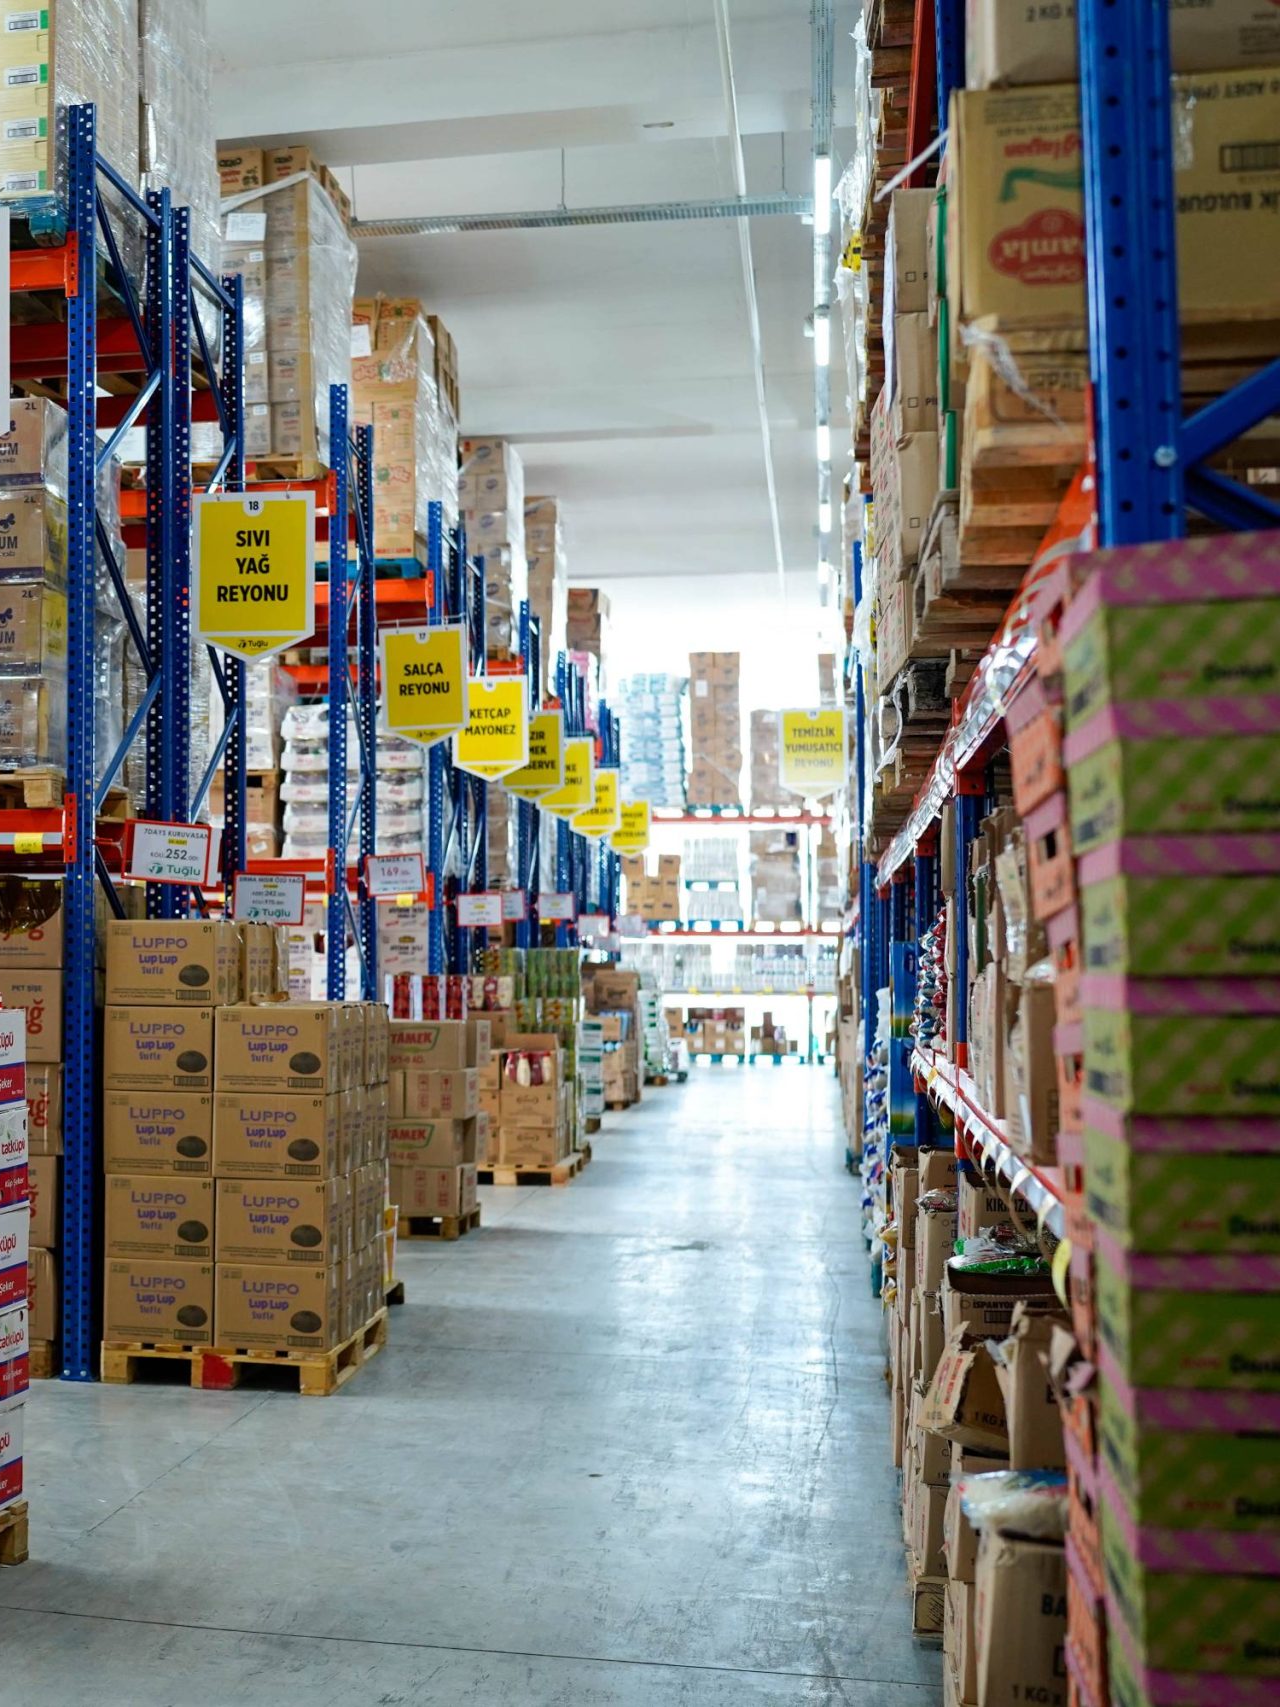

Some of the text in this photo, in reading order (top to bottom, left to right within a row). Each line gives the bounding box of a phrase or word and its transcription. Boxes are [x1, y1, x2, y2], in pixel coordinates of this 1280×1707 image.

[1001, 237, 1081, 262] amla
[25, 401, 37, 410] 2L
[249, 501, 259, 510] 18
[236, 530, 270, 547] SIVI
[236, 554, 270, 574] YAĞ
[22, 590, 33, 598] 2L
[217, 585, 289, 602] REYONU
[404, 662, 444, 678] SALÇA
[399, 681, 450, 696] REYONU
[469, 708, 511, 719] KETÇAP
[464, 724, 516, 736] MAYONEZ
[529, 731, 545, 740] ZIR
[167, 864, 200, 877] Tuğlu
[263, 908, 291, 918] Tuğlu
[132, 936, 188, 949] LUPPO
[139, 954, 178, 965] Lup Lup
[130, 1022, 185, 1035] LUPPO
[242, 1024, 298, 1037] LUPPO
[391, 1029, 433, 1045] TAMEK
[248, 1042, 288, 1053] Lup Lup
[130, 1108, 185, 1120] LUPPO
[240, 1110, 296, 1123] LUPPO
[131, 1191, 187, 1205] LUPPO
[243, 1195, 300, 1209] LUPPO
